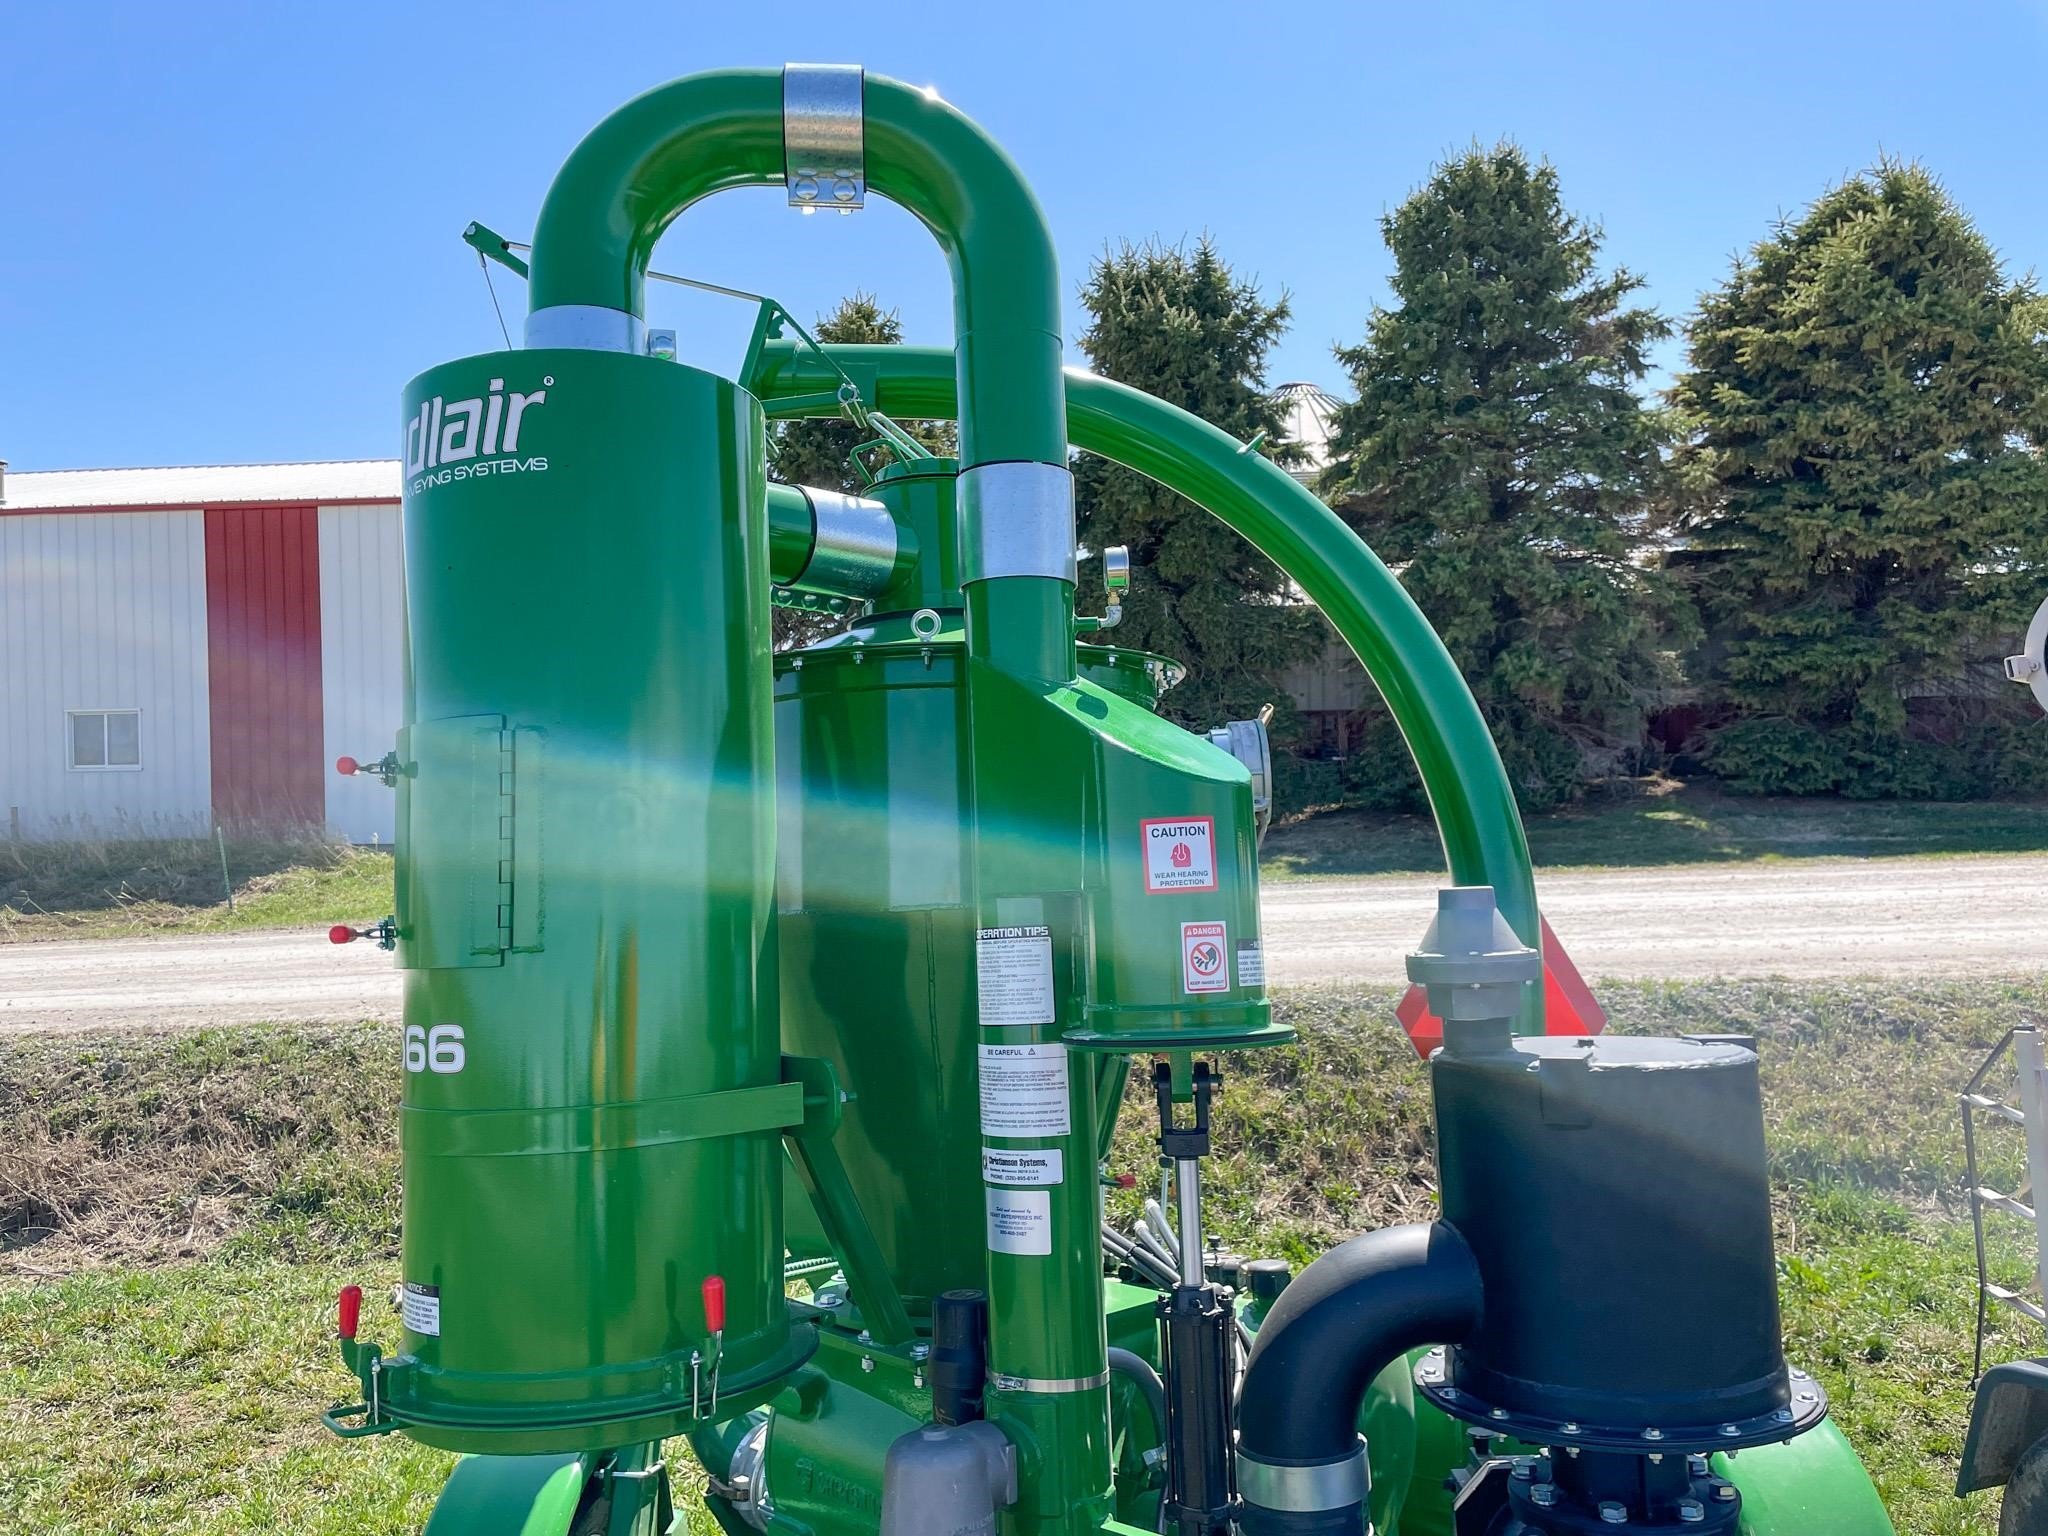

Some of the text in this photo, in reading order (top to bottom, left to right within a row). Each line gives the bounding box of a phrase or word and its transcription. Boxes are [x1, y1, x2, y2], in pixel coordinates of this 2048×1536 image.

[454, 457, 548, 481] SYSTEMS
[1151, 826, 1206, 839] CAUTION
[1154, 870, 1209, 879] WEAR HEARING
[1159, 878, 1205, 887] PROTECTION
[1024, 926, 1049, 936] TIPS
[1192, 927, 1221, 935] DANGER
[406, 1024, 466, 1074] 66
[987, 1048, 994, 1056] BE
[1019, 1158, 1048, 1168] Systems,
